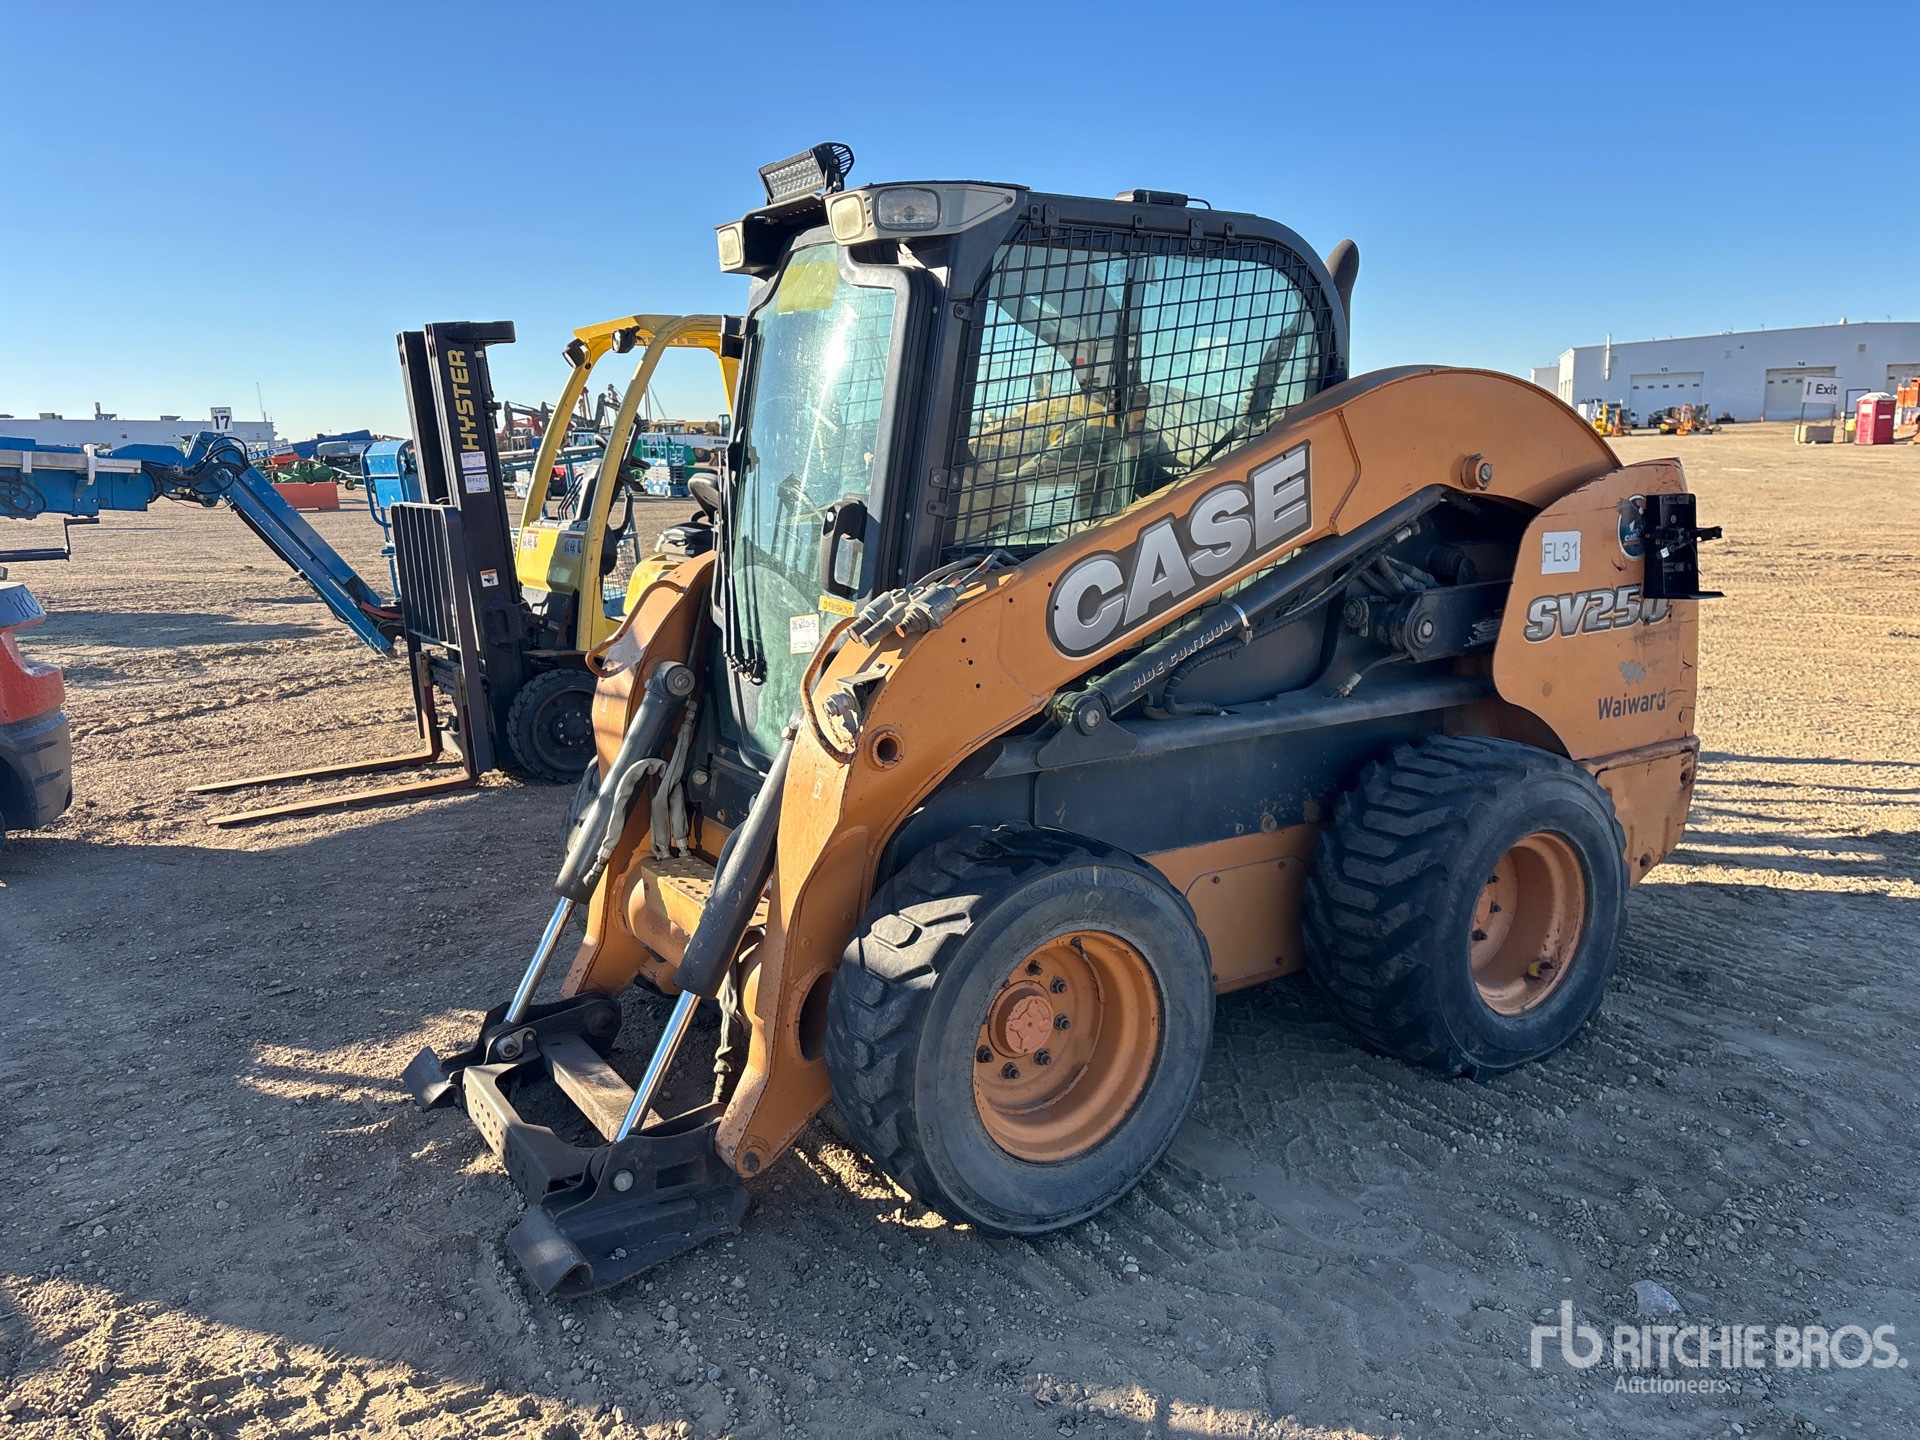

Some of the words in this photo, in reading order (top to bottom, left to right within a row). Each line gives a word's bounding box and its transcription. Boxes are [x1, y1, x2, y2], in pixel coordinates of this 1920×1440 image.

[447, 349, 480, 451] HYSTER
[1815, 383, 1837, 395] Exit
[213, 415, 230, 430] 17
[1049, 445, 1311, 656] CASE
[1543, 541, 1578, 563] FL31
[1523, 583, 1670, 643] SV250
[1131, 661, 1166, 693] RIDE
[1169, 619, 1233, 668] CONTROL
[1597, 686, 1667, 720] Waiward
